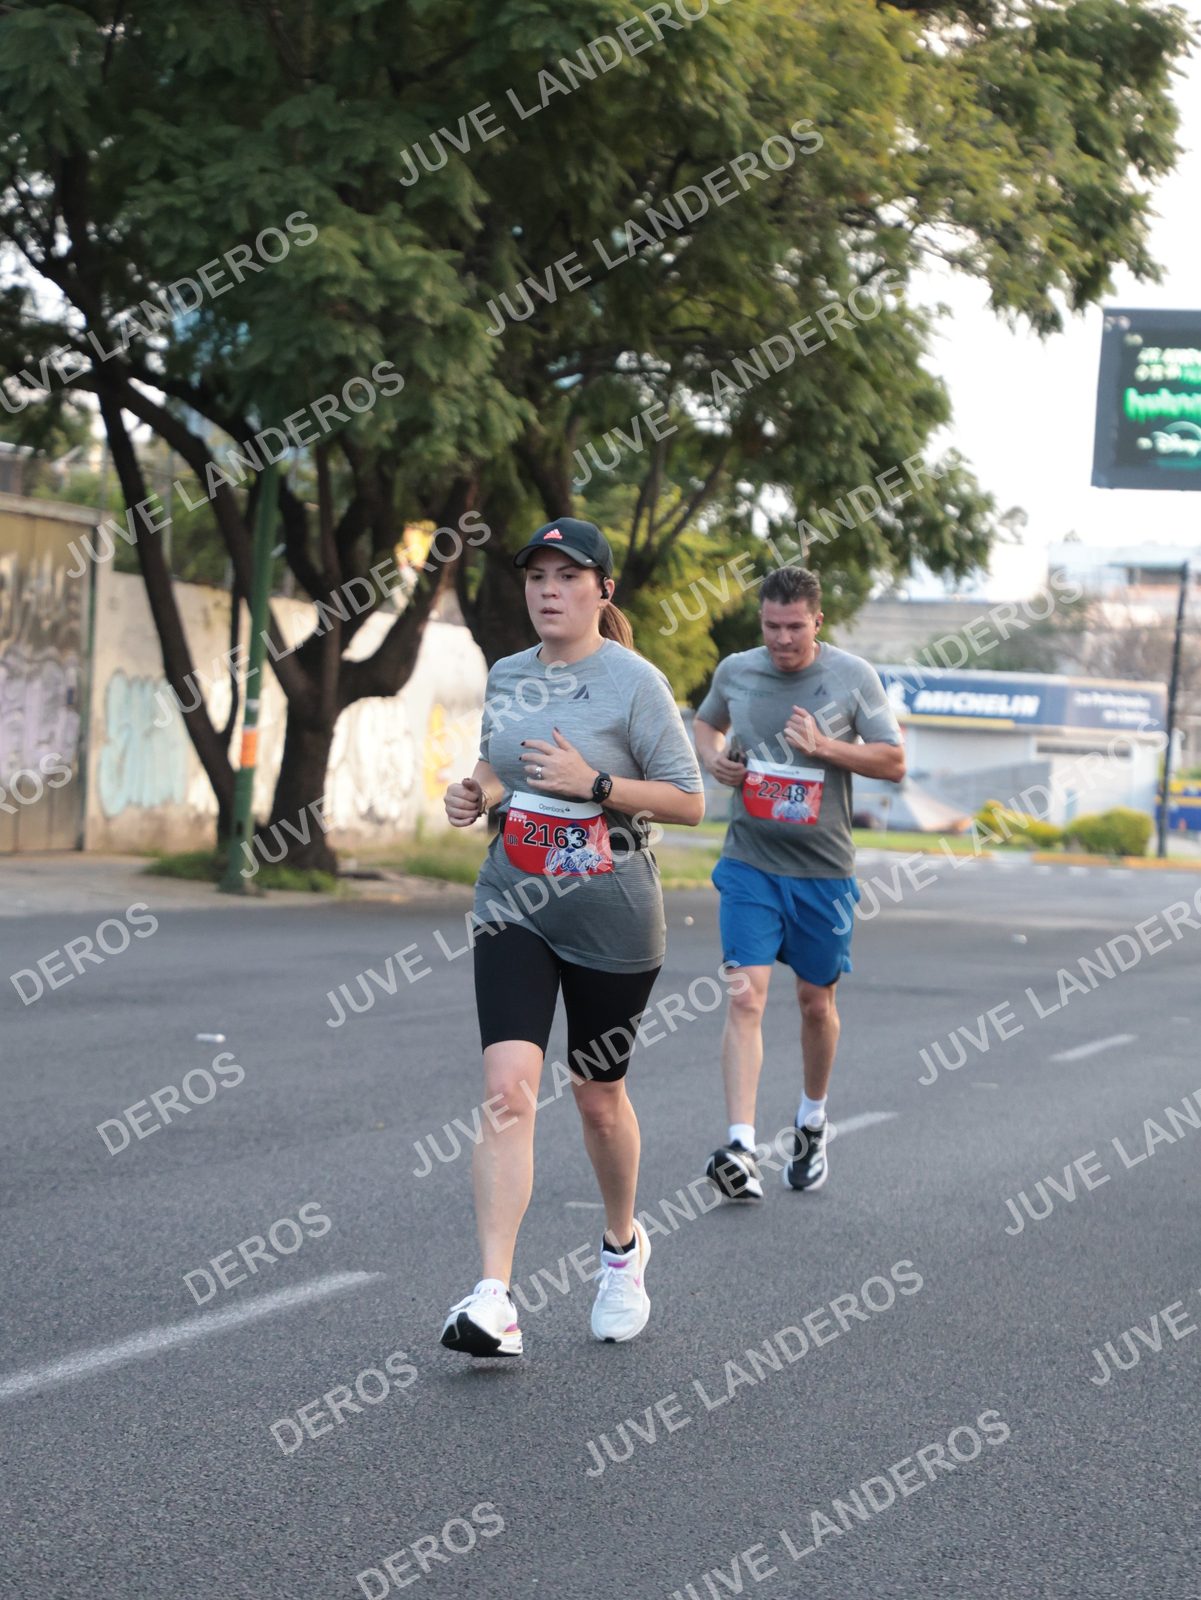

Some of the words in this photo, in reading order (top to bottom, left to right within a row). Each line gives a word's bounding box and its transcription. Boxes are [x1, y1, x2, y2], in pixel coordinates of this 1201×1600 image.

[914, 690, 1040, 717] MICHELIN
[758, 781, 806, 803] 2248
[523, 820, 587, 849] 2163
